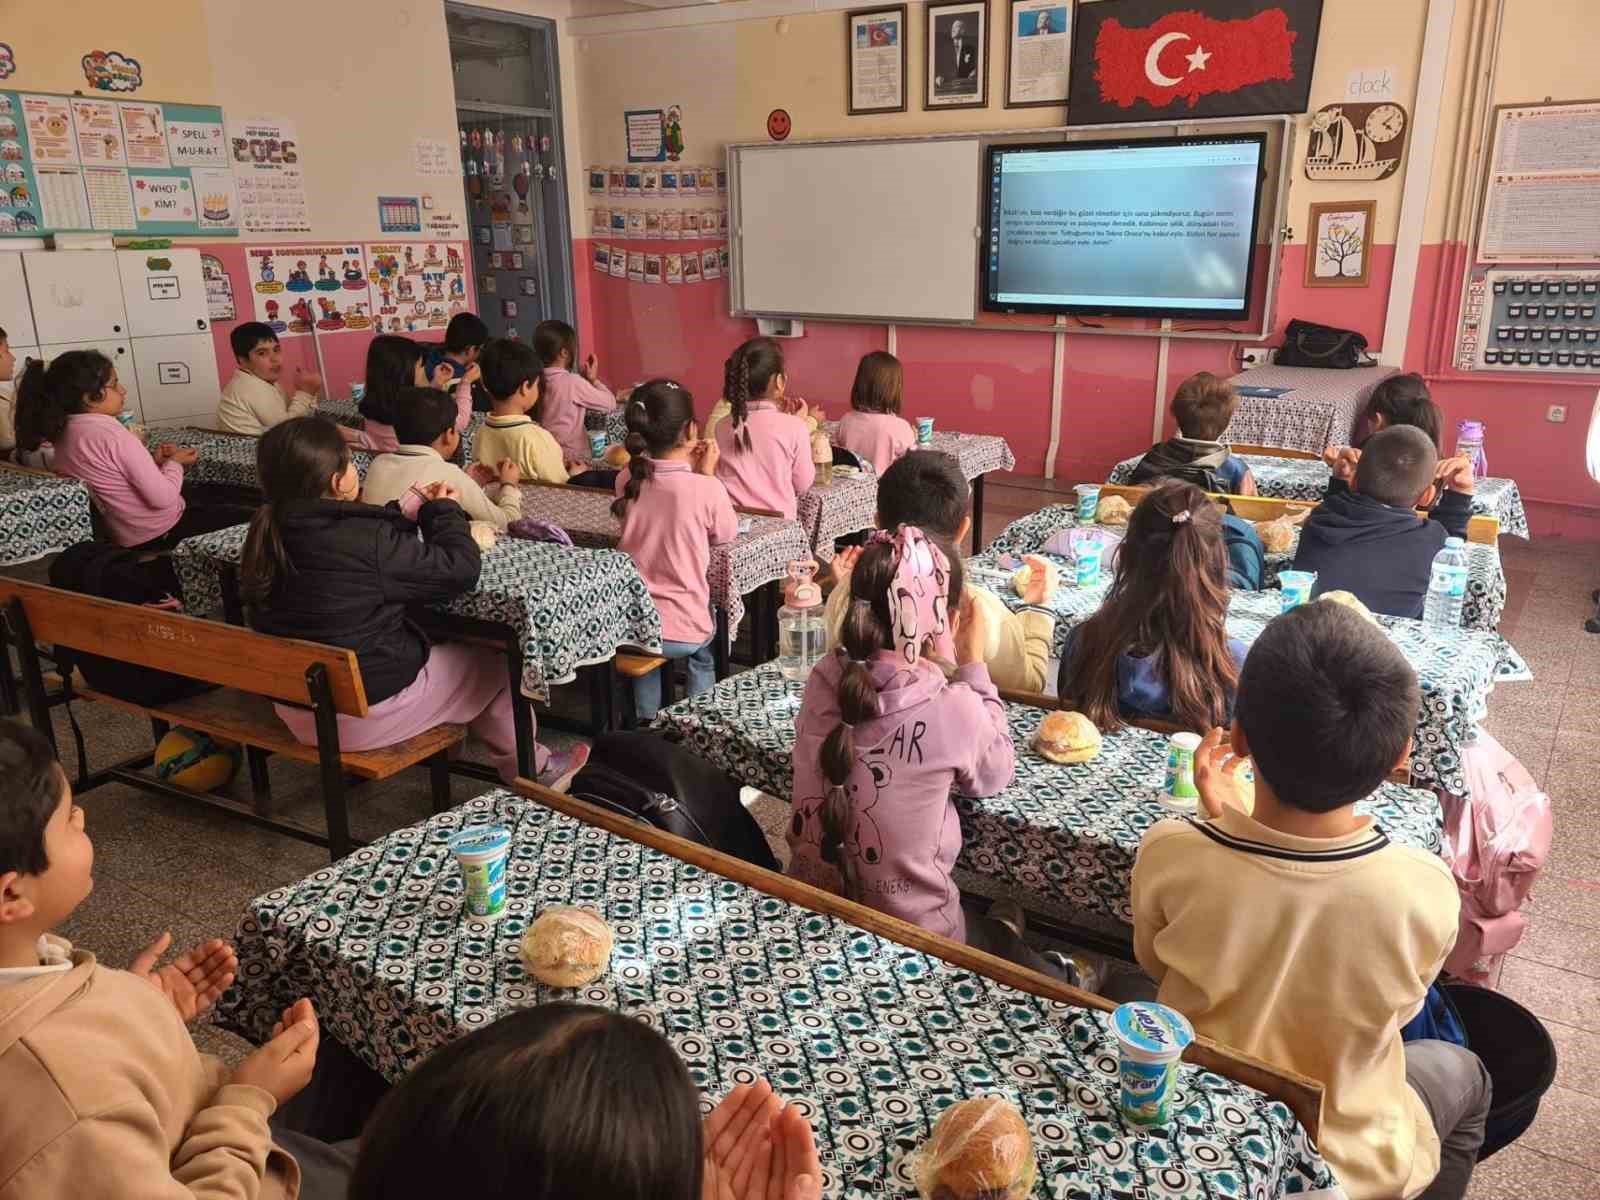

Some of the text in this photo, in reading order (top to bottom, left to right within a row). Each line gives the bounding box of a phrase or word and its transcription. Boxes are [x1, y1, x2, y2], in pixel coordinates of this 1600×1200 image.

[1349, 69, 1391, 96] clock
[182, 129, 208, 140] SPELL
[149, 184, 177, 194] WHO?
[870, 721, 926, 764] AR
